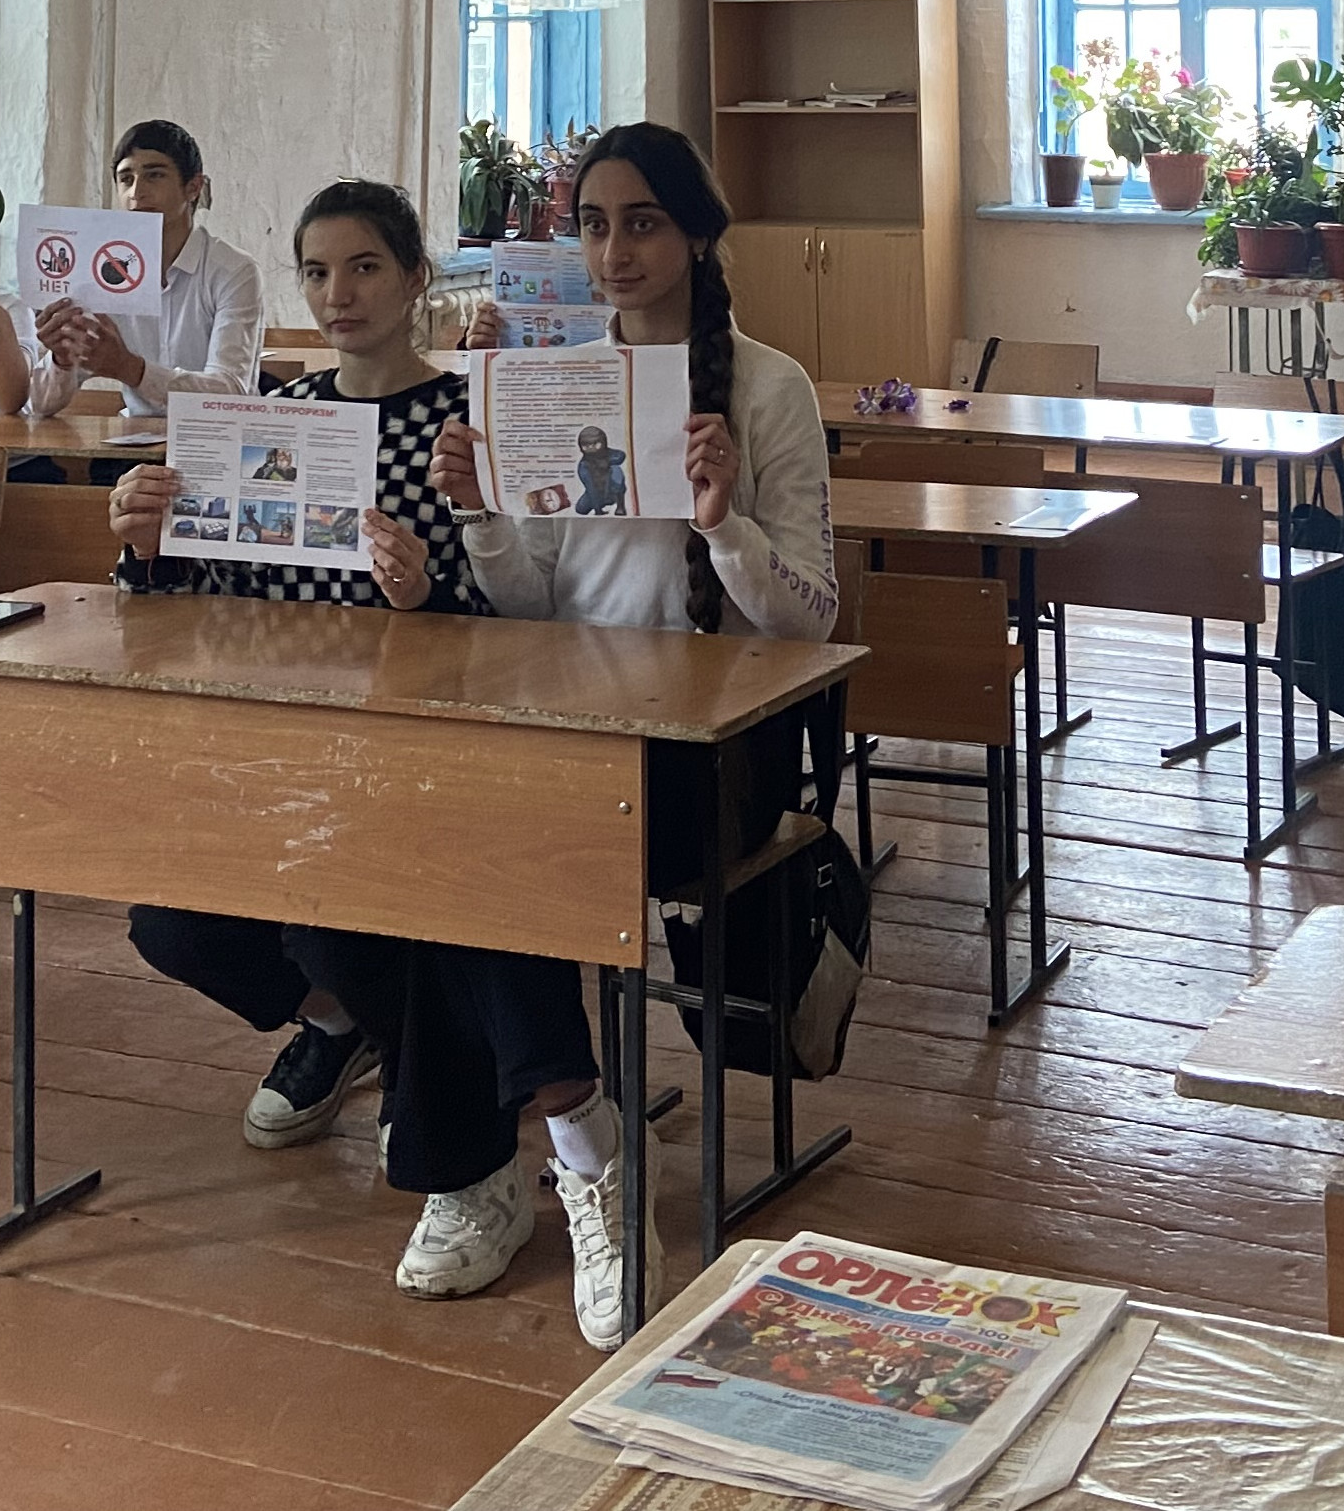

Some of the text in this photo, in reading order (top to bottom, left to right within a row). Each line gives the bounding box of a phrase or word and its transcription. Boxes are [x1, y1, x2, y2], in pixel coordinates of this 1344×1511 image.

[39, 279, 70, 293] НЕТ
[273, 405, 338, 418] ТЕРРОРИЗМ!
[786, 1301, 872, 1331] Днём
[877, 1321, 1019, 1360] Победы!
